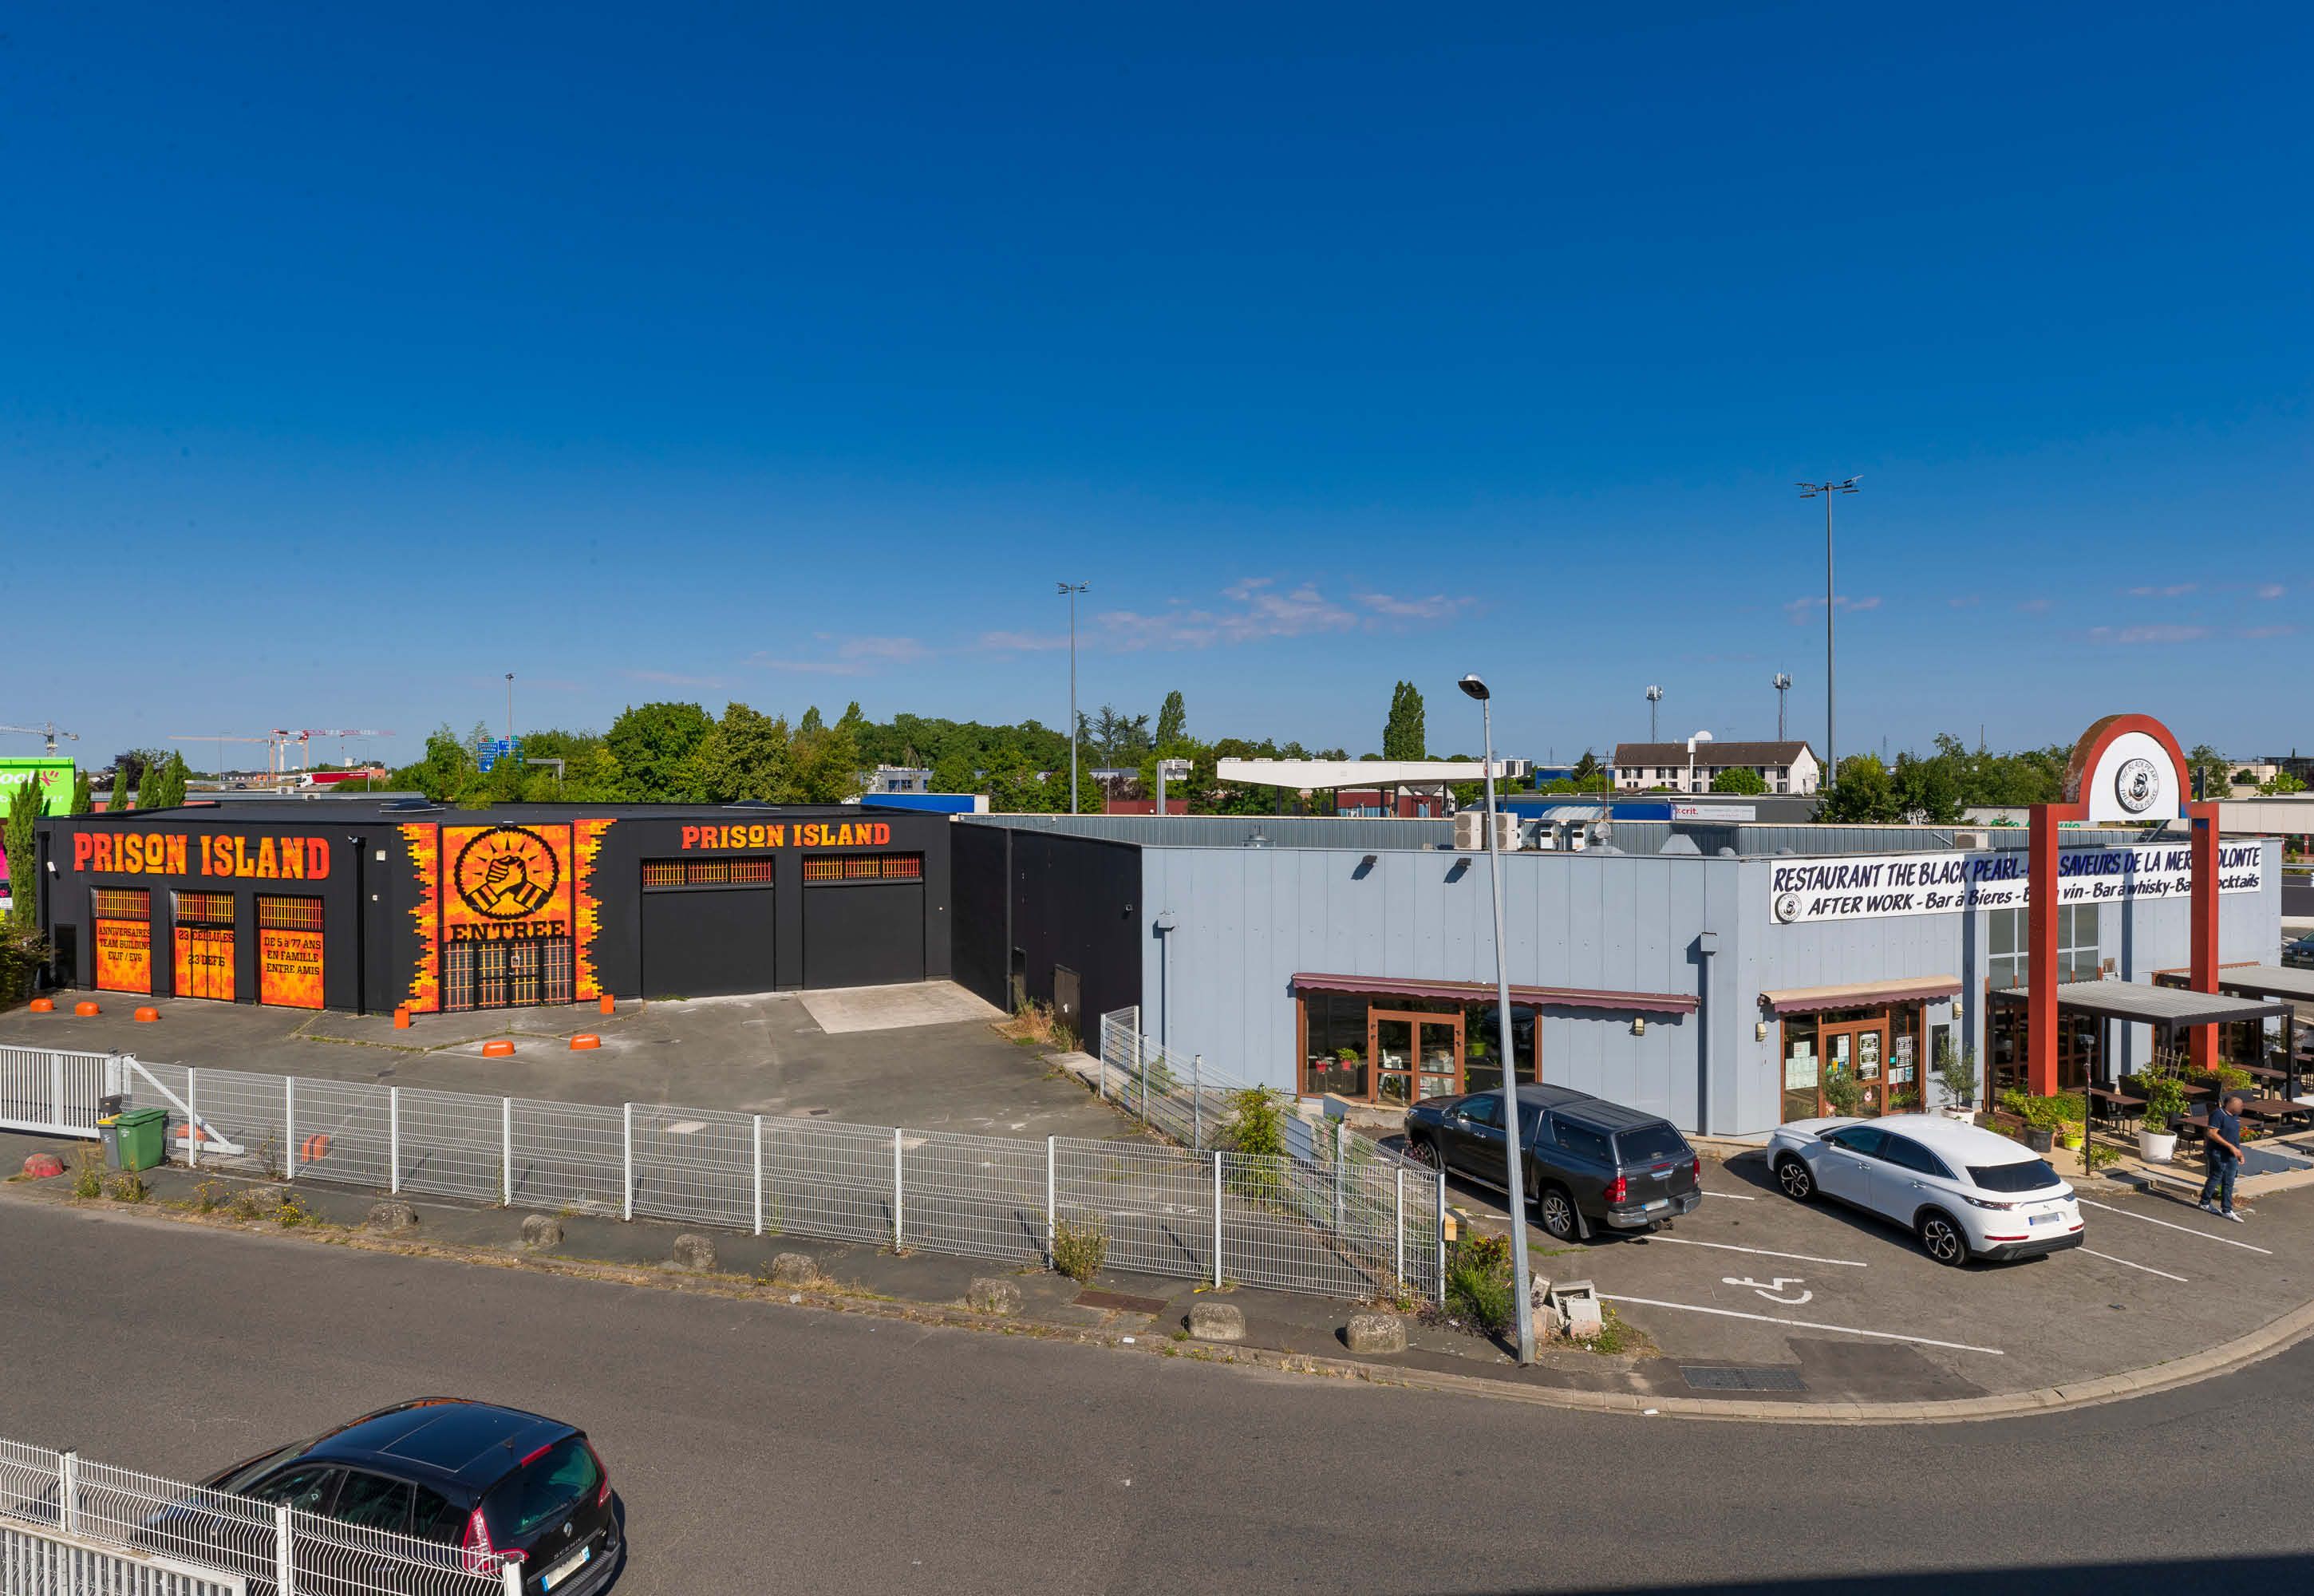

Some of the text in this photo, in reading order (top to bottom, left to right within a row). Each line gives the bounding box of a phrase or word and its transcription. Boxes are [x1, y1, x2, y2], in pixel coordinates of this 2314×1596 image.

[681, 823, 891, 850] PRISON ISLAND
[73, 832, 330, 880] PRISON ISLAND
[1773, 864, 1884, 892] RESTAURANT
[1887, 863, 1917, 887] THE
[1918, 860, 1970, 887] BLACK
[2059, 855, 2120, 877] SAVEURS
[2123, 852, 2142, 874] DE
[2144, 851, 2161, 872] LA
[1807, 895, 1866, 916] AFTER
[1866, 894, 1915, 912] WORK
[1925, 891, 1954, 910] Bar
[1955, 891, 1965, 907] à
[98, 926, 151, 938] ANNIVERSAIRES
[179, 930, 235, 943] 23 CELLULES
[450, 920, 566, 943] ENTREE
[99, 938, 151, 950] TEAM BUILDING
[264, 937, 275, 946] DE
[277, 938, 282, 947] 5
[290, 938, 302, 948] 77
[303, 939, 321, 950] ANS
[188, 954, 199, 965] 23
[267, 950, 319, 963] EN FAMILLE
[267, 962, 320, 975] ENTRE AMIS
